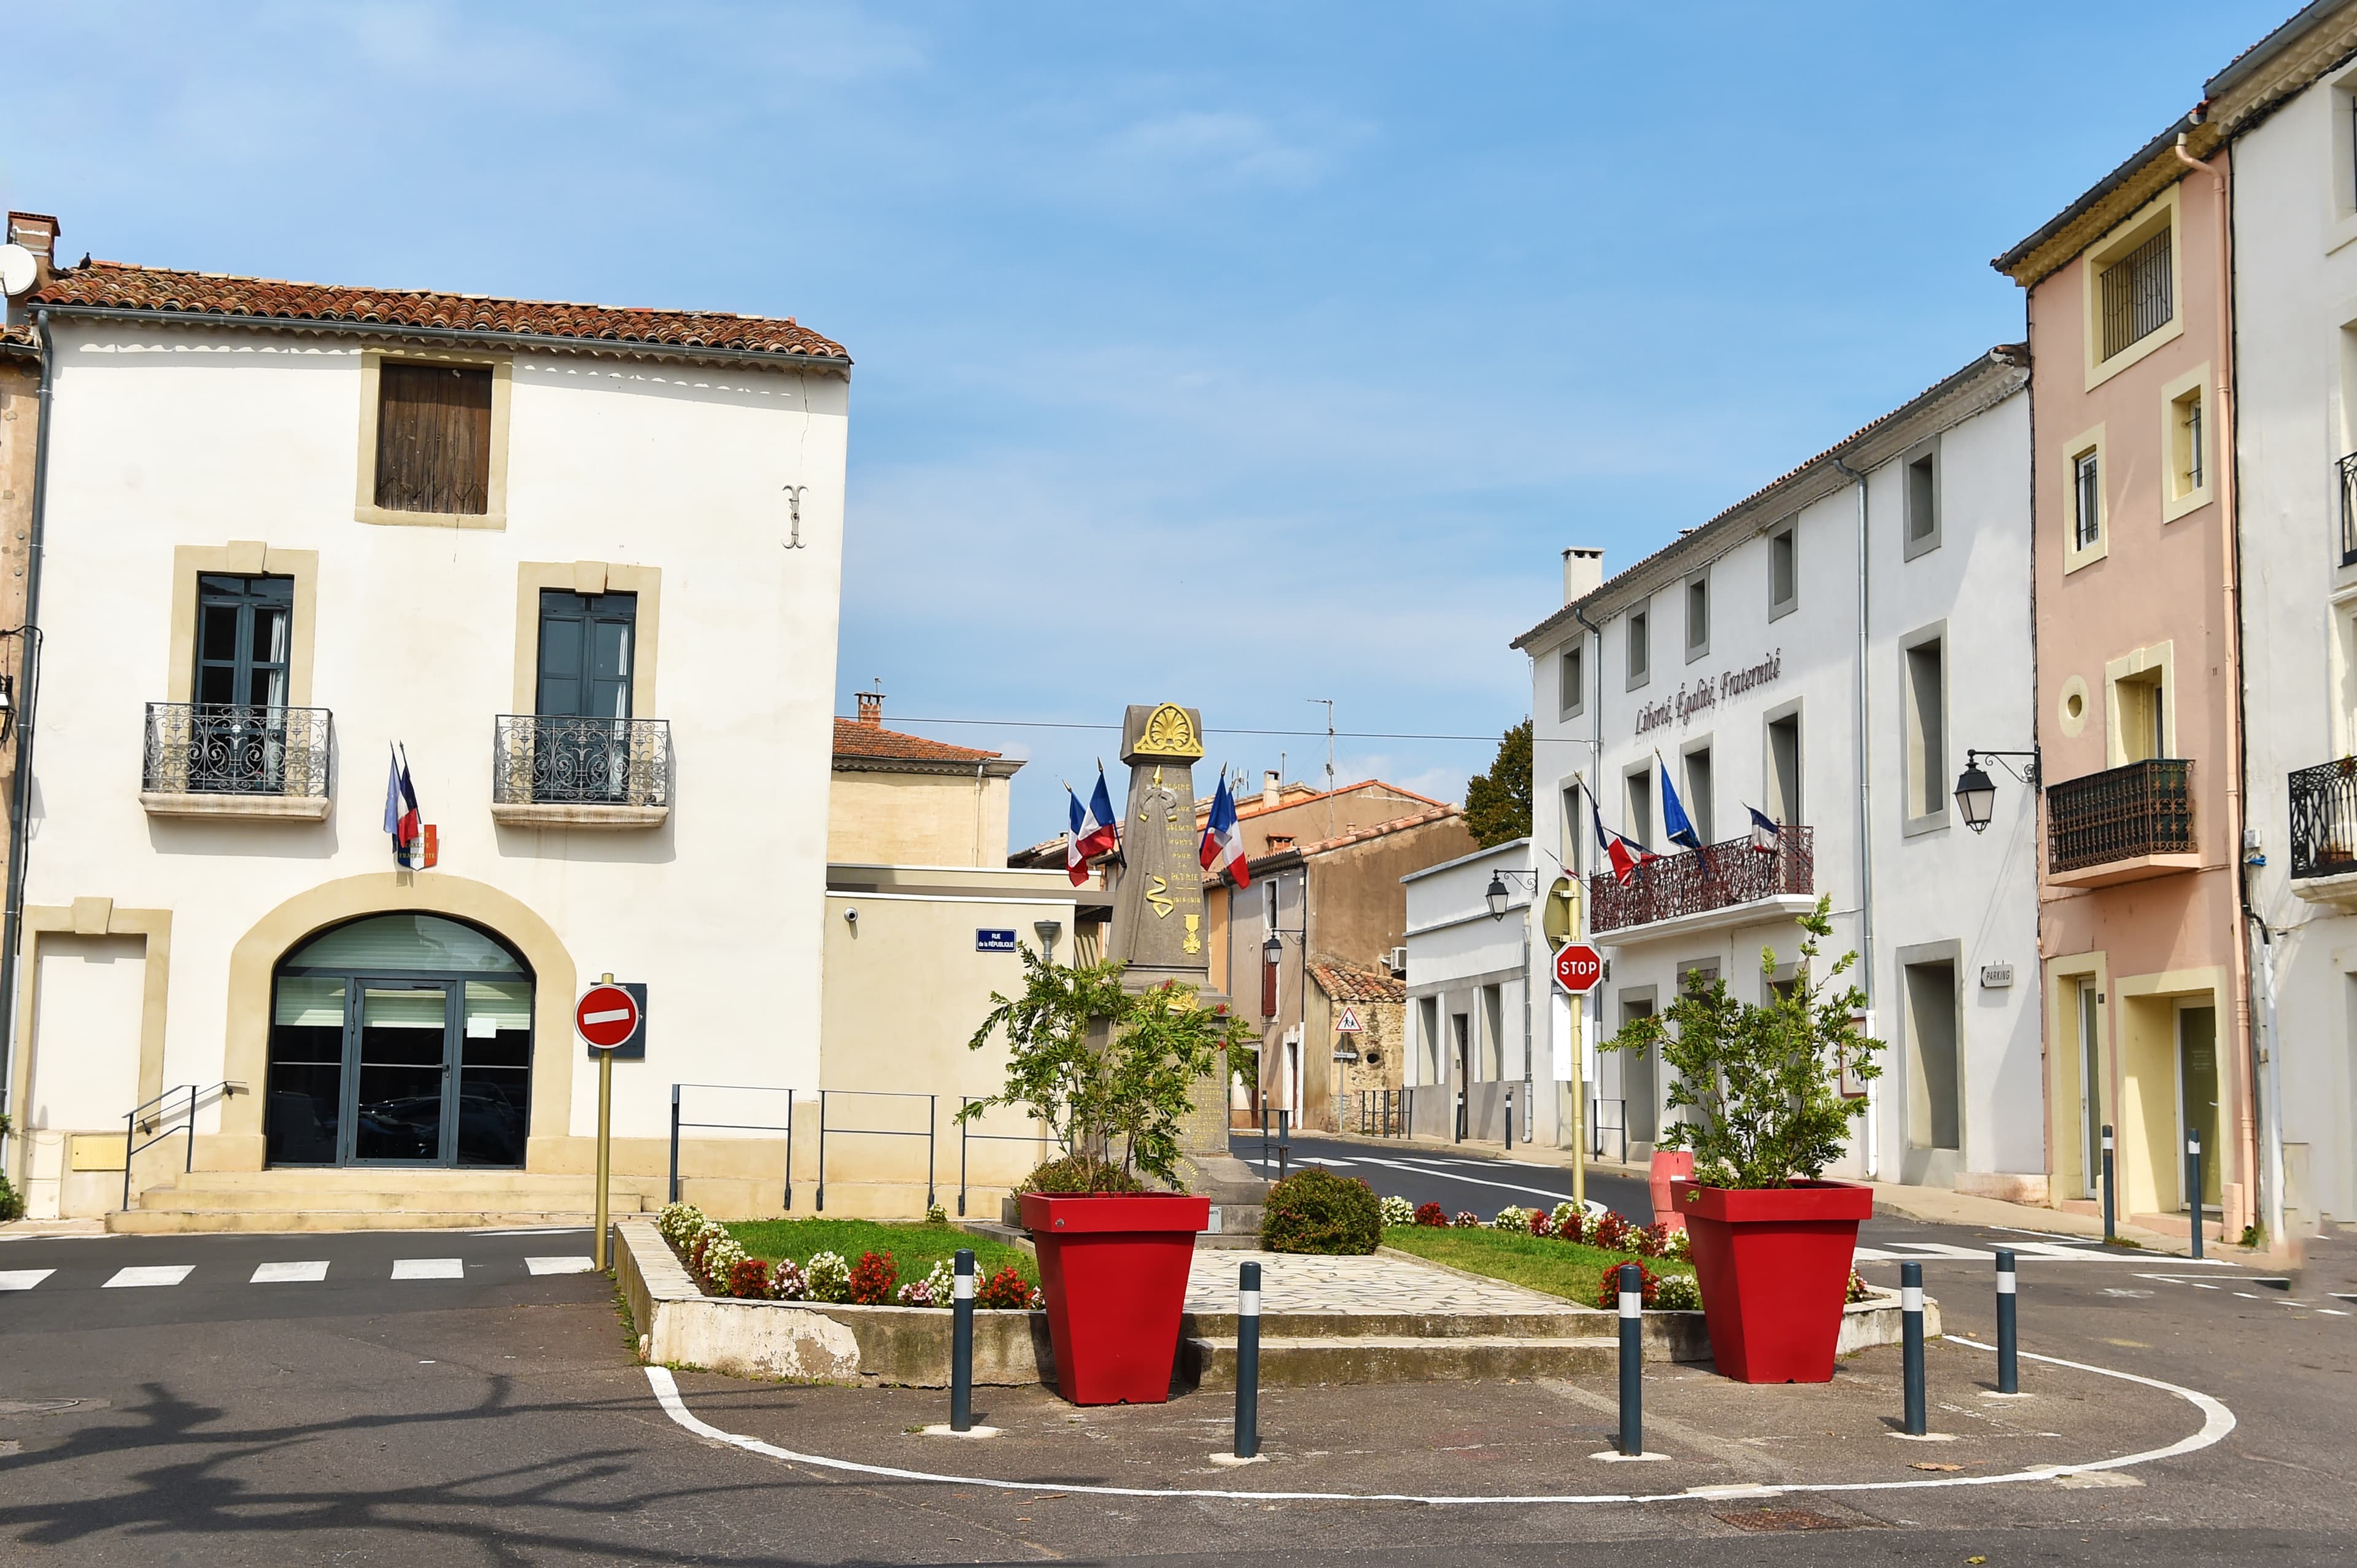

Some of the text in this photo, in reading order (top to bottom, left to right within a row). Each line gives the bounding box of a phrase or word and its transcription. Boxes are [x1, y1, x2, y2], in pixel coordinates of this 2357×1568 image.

[1720, 647, 1781, 700] Fraternité
[1561, 961, 1597, 975] STOP
[1986, 970, 2010, 981] PARKING
